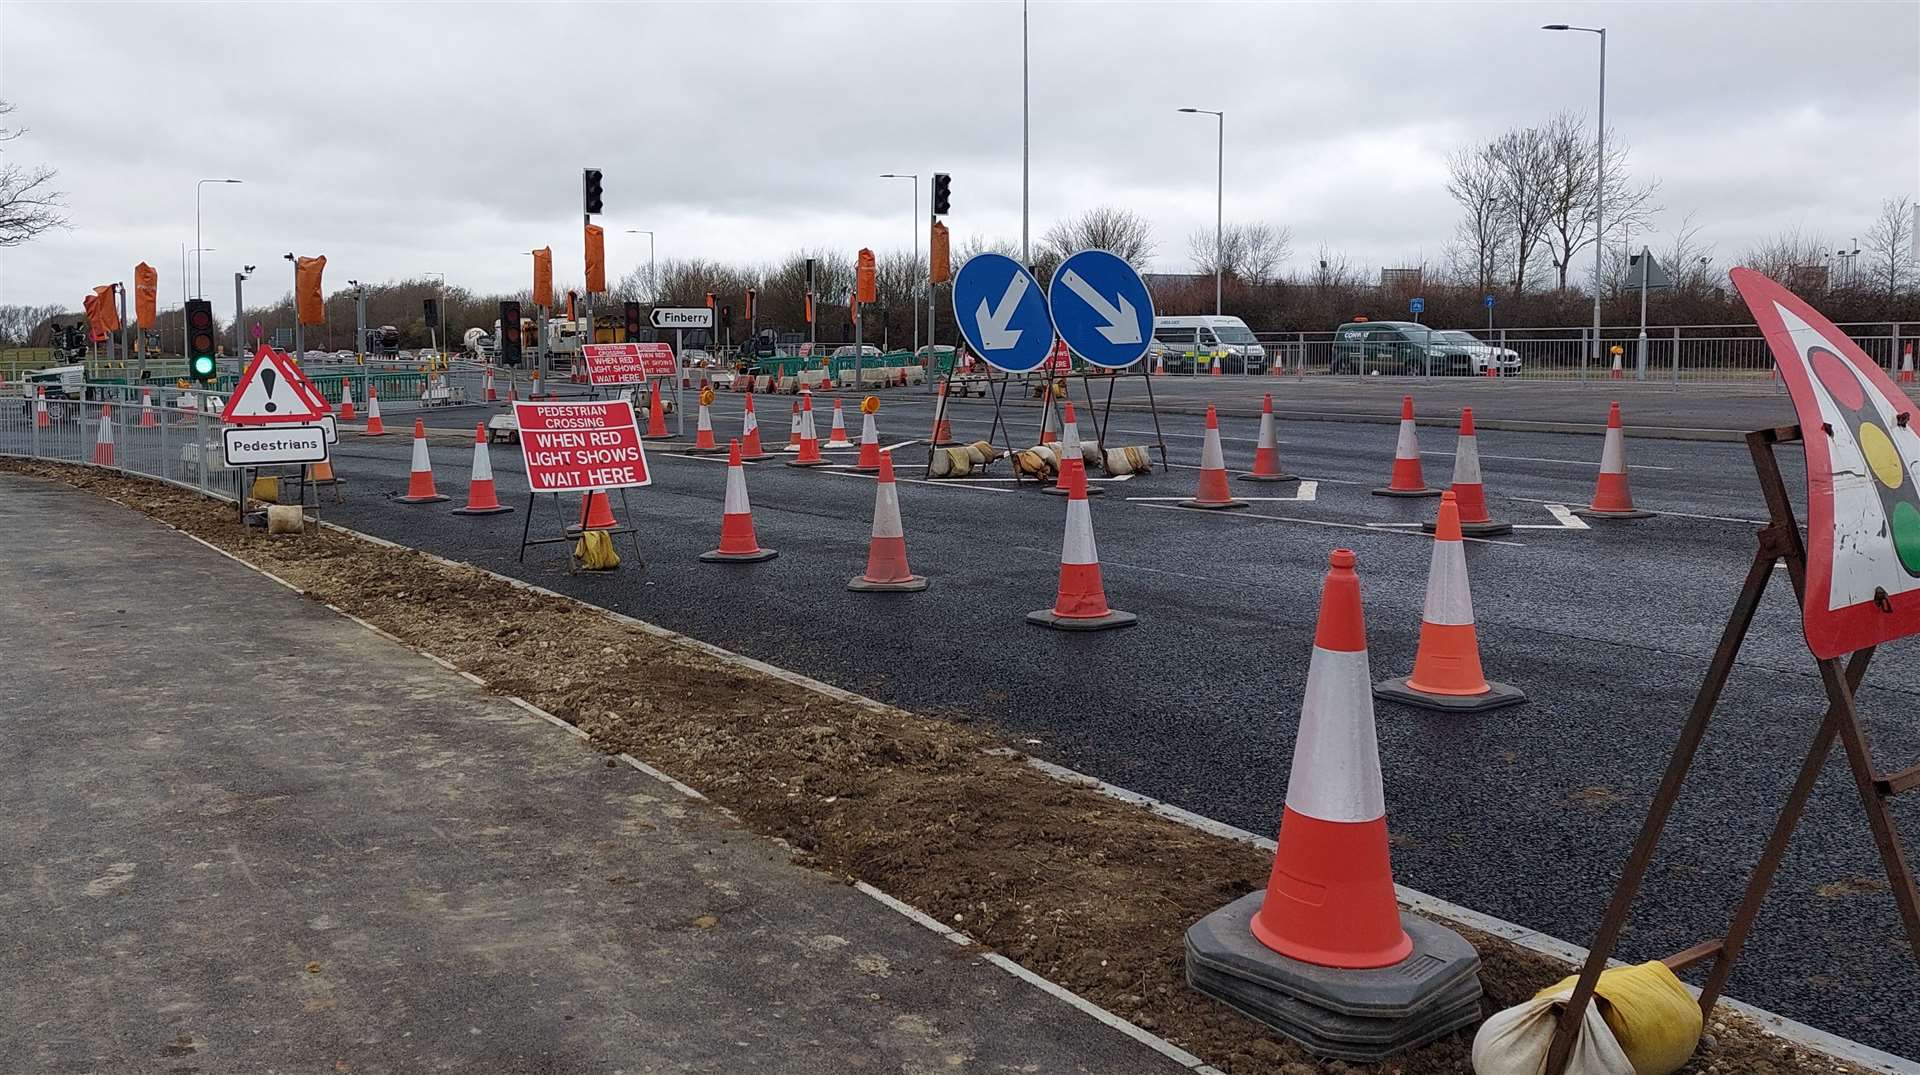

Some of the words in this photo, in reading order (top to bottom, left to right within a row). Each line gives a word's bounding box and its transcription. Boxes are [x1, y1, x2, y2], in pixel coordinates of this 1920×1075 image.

[664, 312, 709, 324] Finberry
[594, 357, 618, 365] WHEN
[619, 356, 634, 364] RED
[590, 365, 612, 373] LIGHT
[613, 364, 642, 372] SHOWS
[596, 374, 616, 382] WAIT
[618, 373, 640, 382] HERE
[537, 405, 607, 417] PEDESTRIAN
[545, 417, 605, 429] CROSSING
[536, 433, 586, 448] WHEN
[590, 431, 622, 446] RED
[234, 440, 318, 452] Pedestrians
[528, 451, 571, 466] LIGHT
[576, 447, 639, 465] SHOWS
[540, 471, 581, 487] WAIT
[588, 467, 637, 485] HERE
